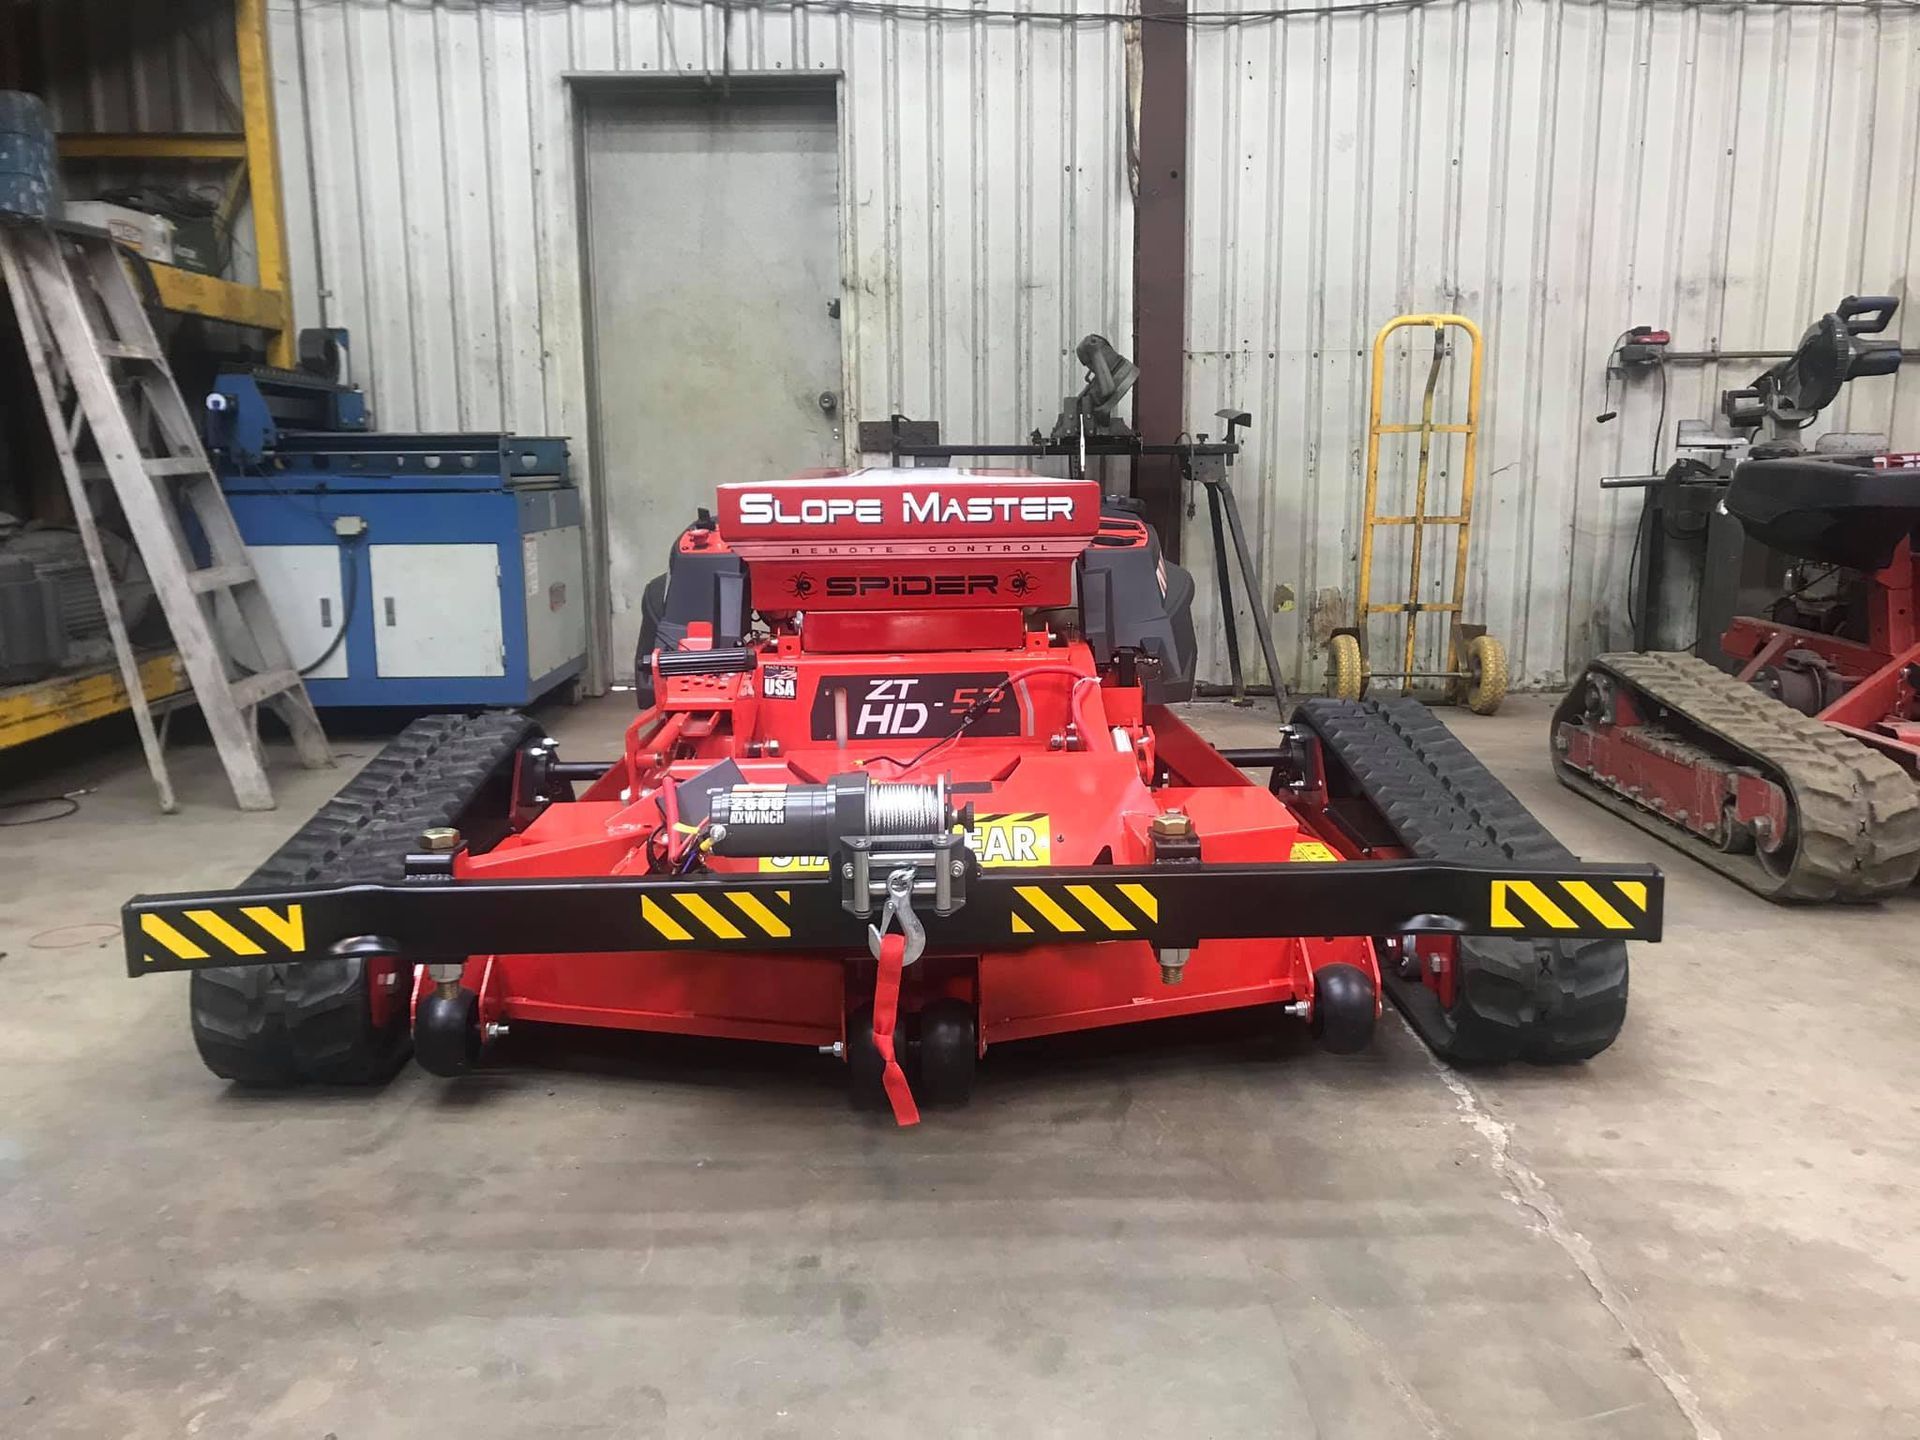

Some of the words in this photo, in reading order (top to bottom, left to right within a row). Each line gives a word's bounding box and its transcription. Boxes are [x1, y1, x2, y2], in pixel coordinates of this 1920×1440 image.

[739, 493, 883, 524] SLOPE
[902, 491, 1074, 523] MASTER
[791, 546, 894, 555] REMOTE
[928, 544, 1048, 553] CONTROL
[764, 678, 796, 697] USA
[865, 679, 919, 700] ZT
[744, 810, 785, 824] WINCH
[963, 826, 1039, 861] EAR
